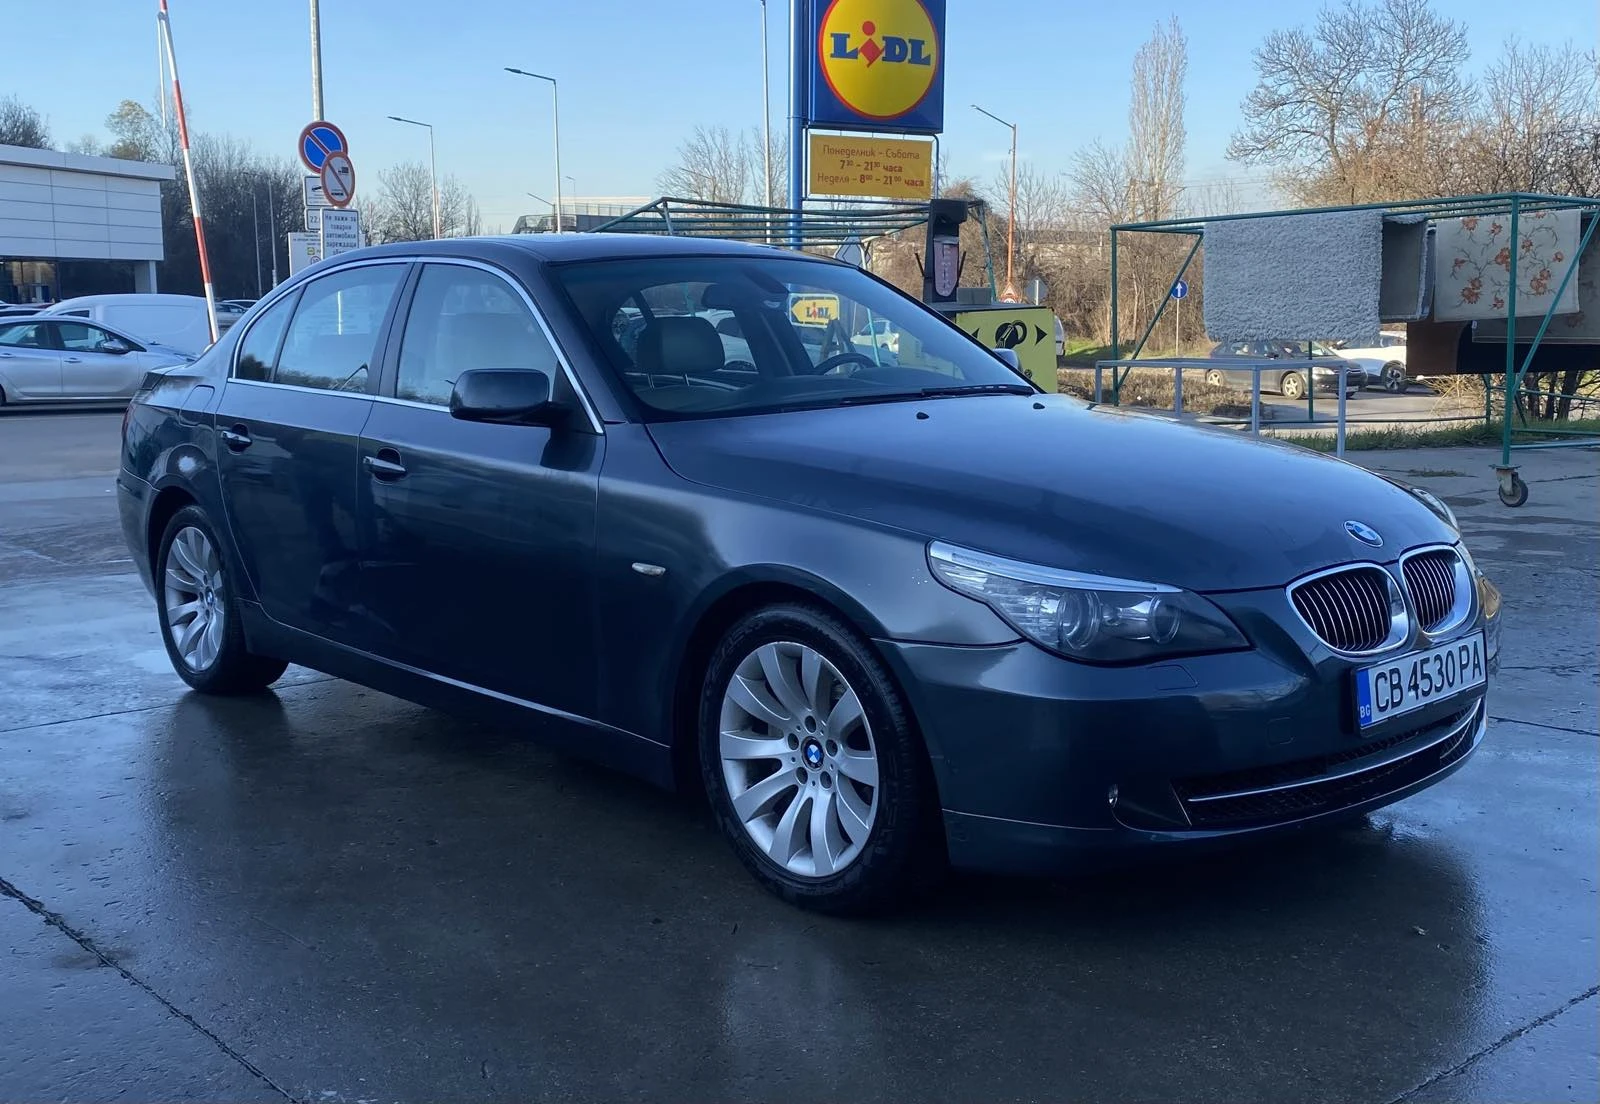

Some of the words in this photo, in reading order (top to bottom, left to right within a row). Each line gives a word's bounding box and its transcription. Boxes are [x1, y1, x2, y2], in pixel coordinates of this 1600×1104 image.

[823, 144, 876, 158] Понеделник
[885, 147, 920, 160] Събота
[882, 164, 903, 173] часа
[817, 173, 850, 185] Неделя
[904, 178, 924, 188] часа
[1374, 667, 1404, 712] CB
[1408, 650, 1456, 701] 4530
[1458, 639, 1483, 684] PA
[1360, 704, 1371, 718] BG
